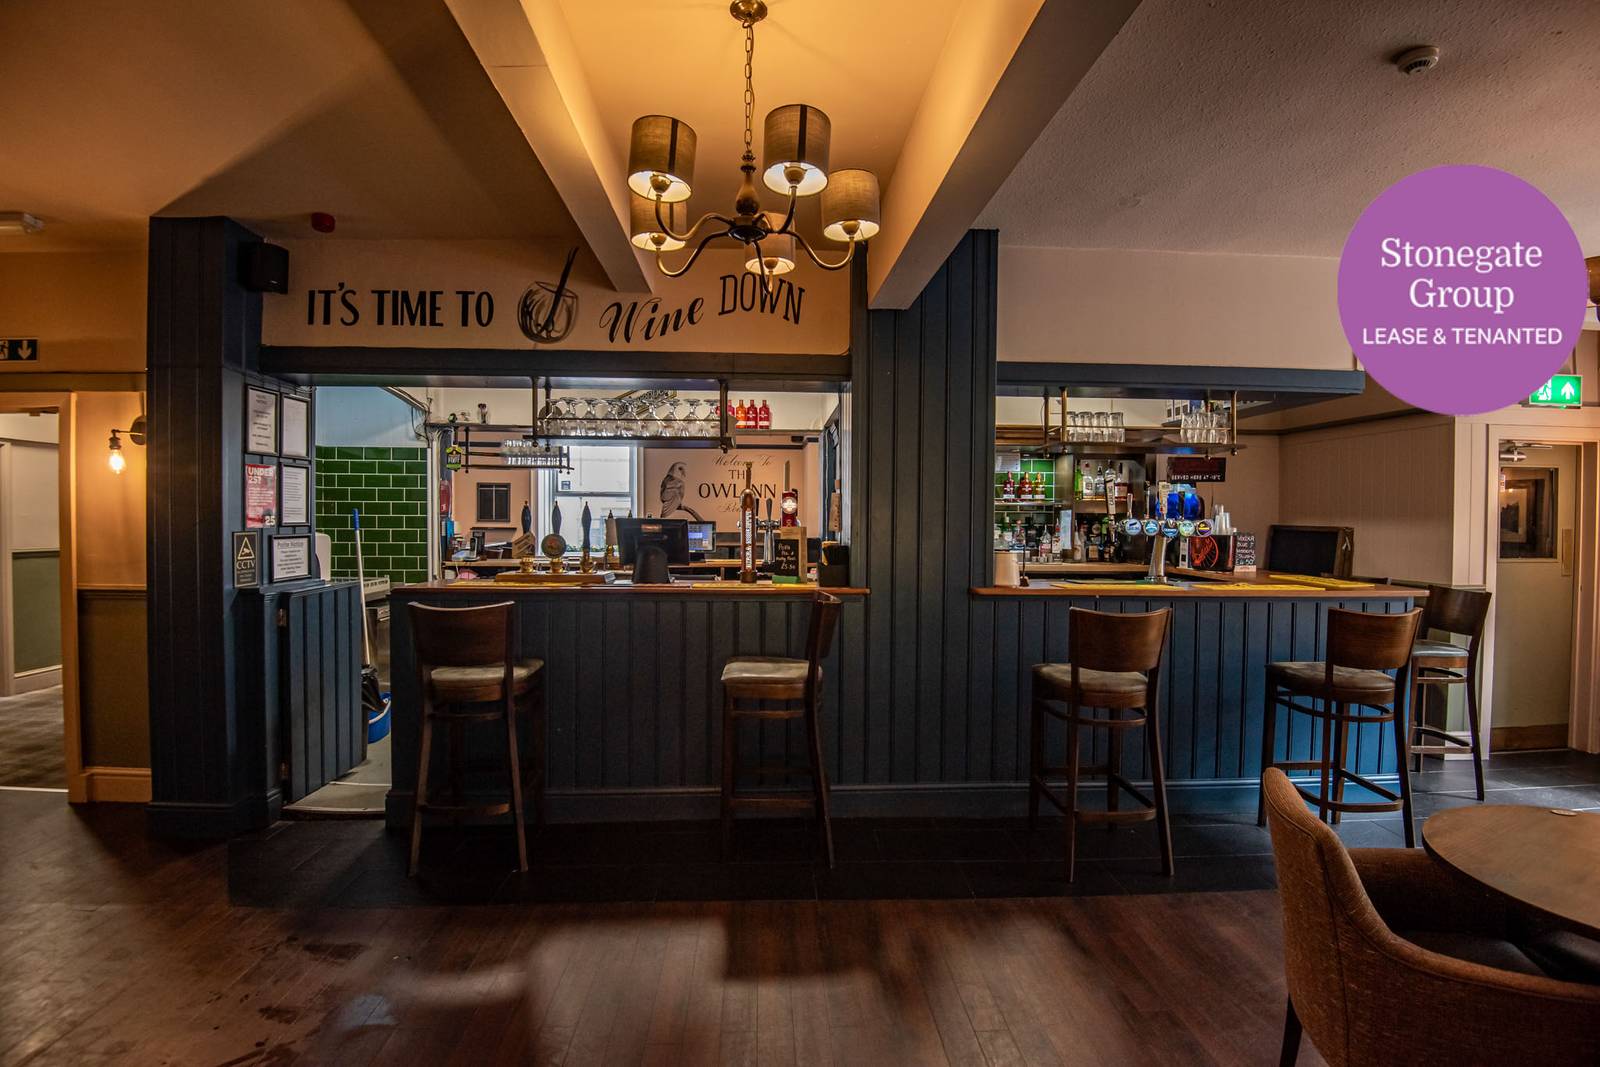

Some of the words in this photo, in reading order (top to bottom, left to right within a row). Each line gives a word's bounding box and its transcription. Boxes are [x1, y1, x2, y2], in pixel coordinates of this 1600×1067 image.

[307, 282, 360, 327] IT'S
[371, 290, 444, 327] TIME
[456, 291, 495, 328] TO
[599, 297, 705, 344] Wine
[718, 271, 806, 325] DOWN
[247, 468, 274, 477] UNDER
[728, 469, 745, 480] TH
[698, 482, 741, 499] OWL
[751, 483, 777, 499] NN
[264, 515, 276, 526] 25
[236, 560, 256, 570] CCTV
